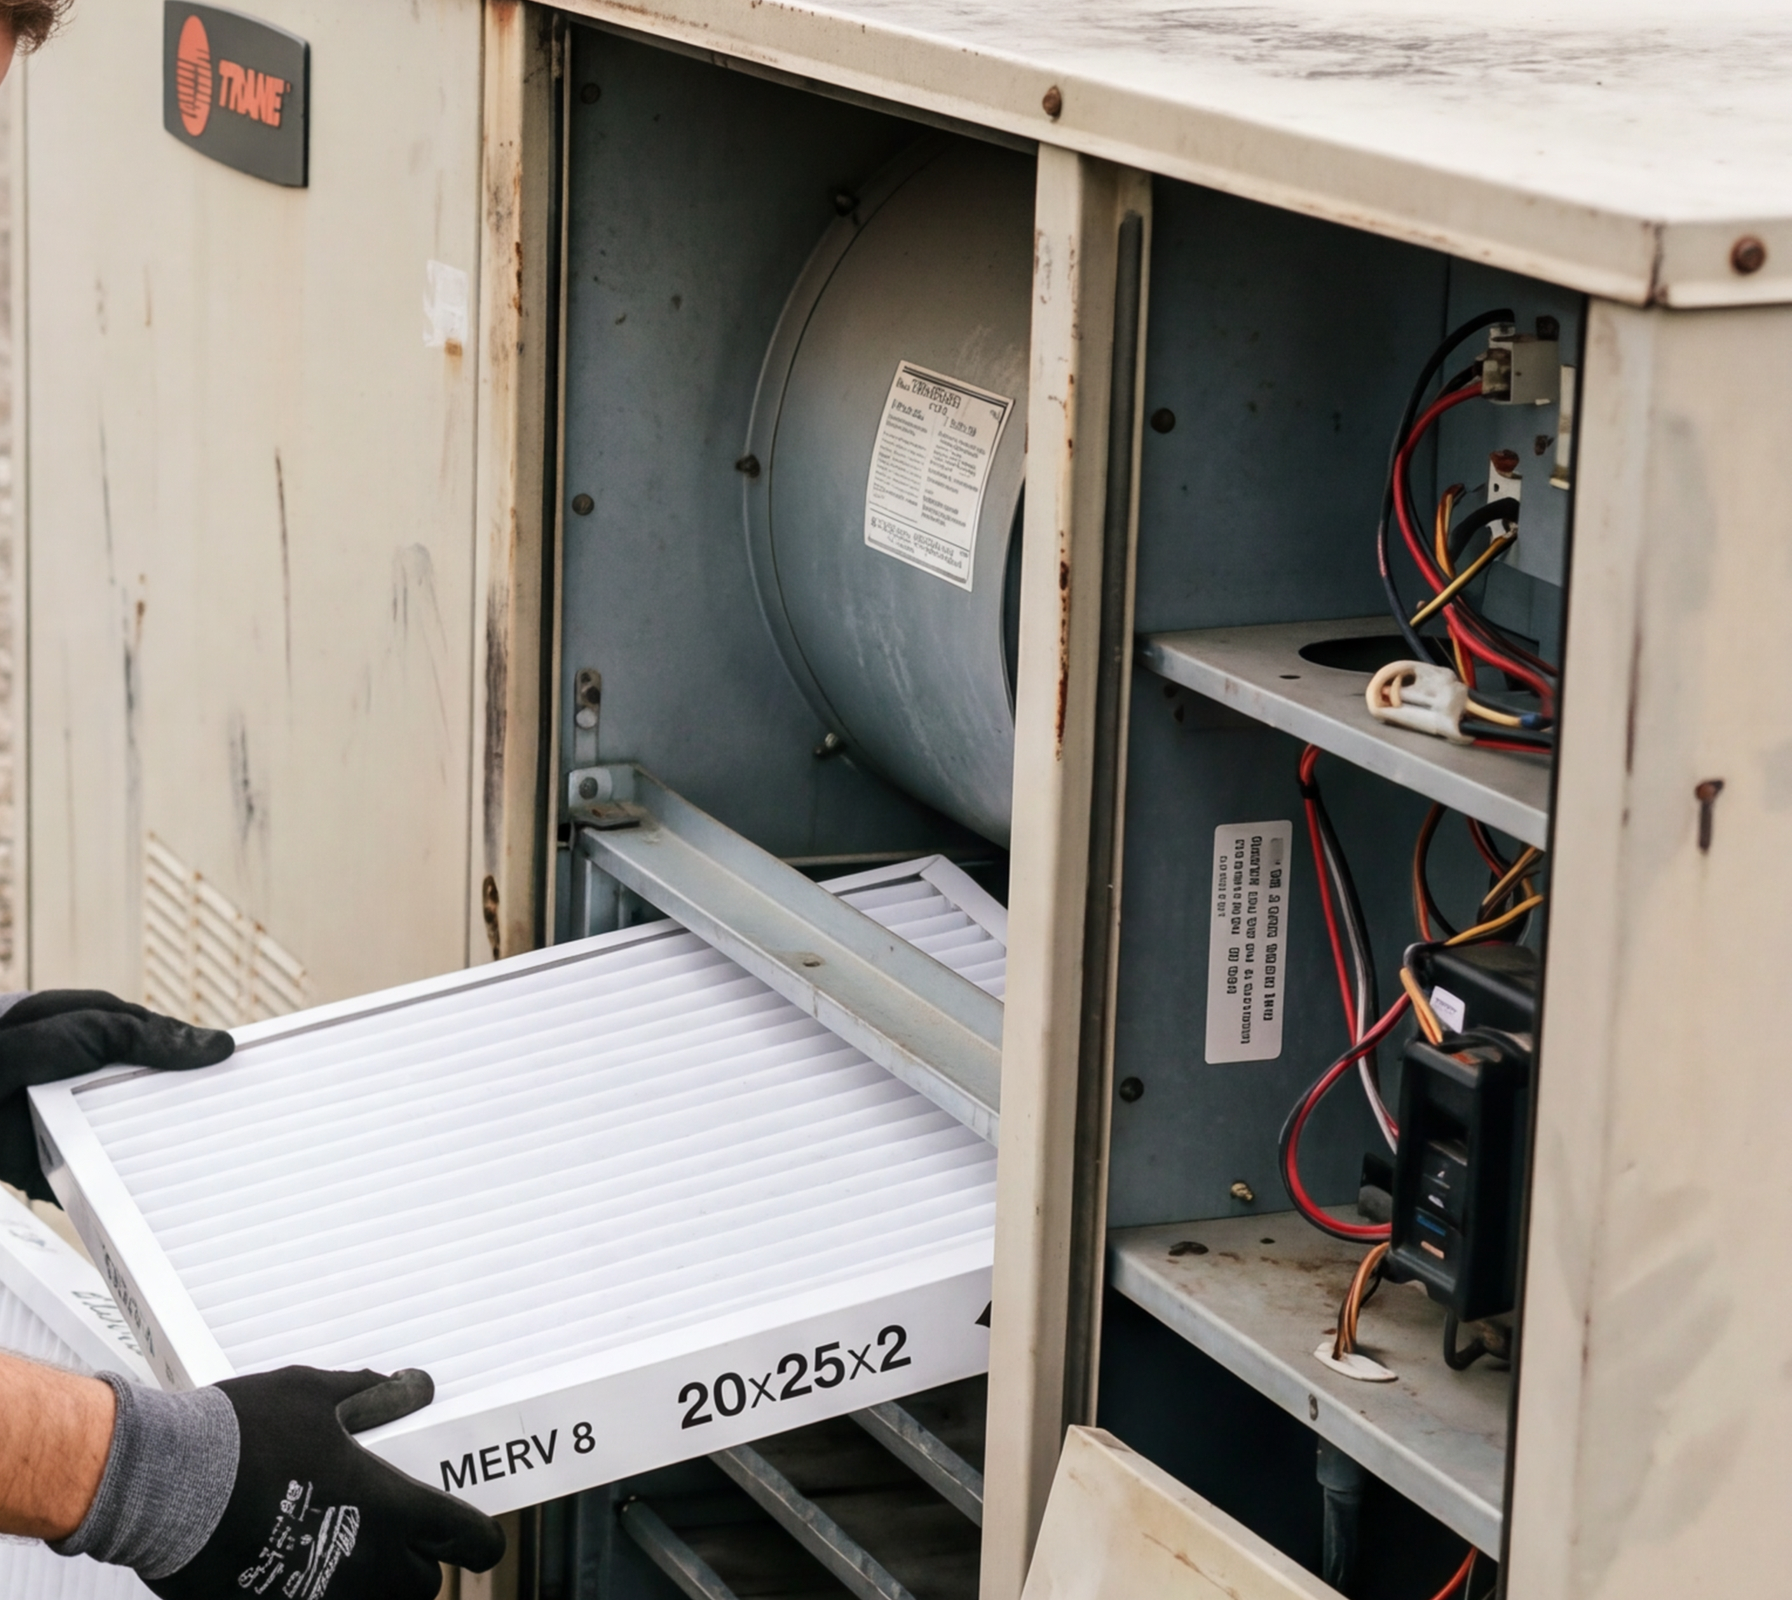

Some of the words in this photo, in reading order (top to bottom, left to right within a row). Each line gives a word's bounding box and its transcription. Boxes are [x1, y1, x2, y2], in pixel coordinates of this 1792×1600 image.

[219, 59, 284, 128] TRANE
[677, 1324, 913, 1430] 20x25x2
[439, 1428, 558, 1493] MERV
[572, 1421, 597, 1454] 8
